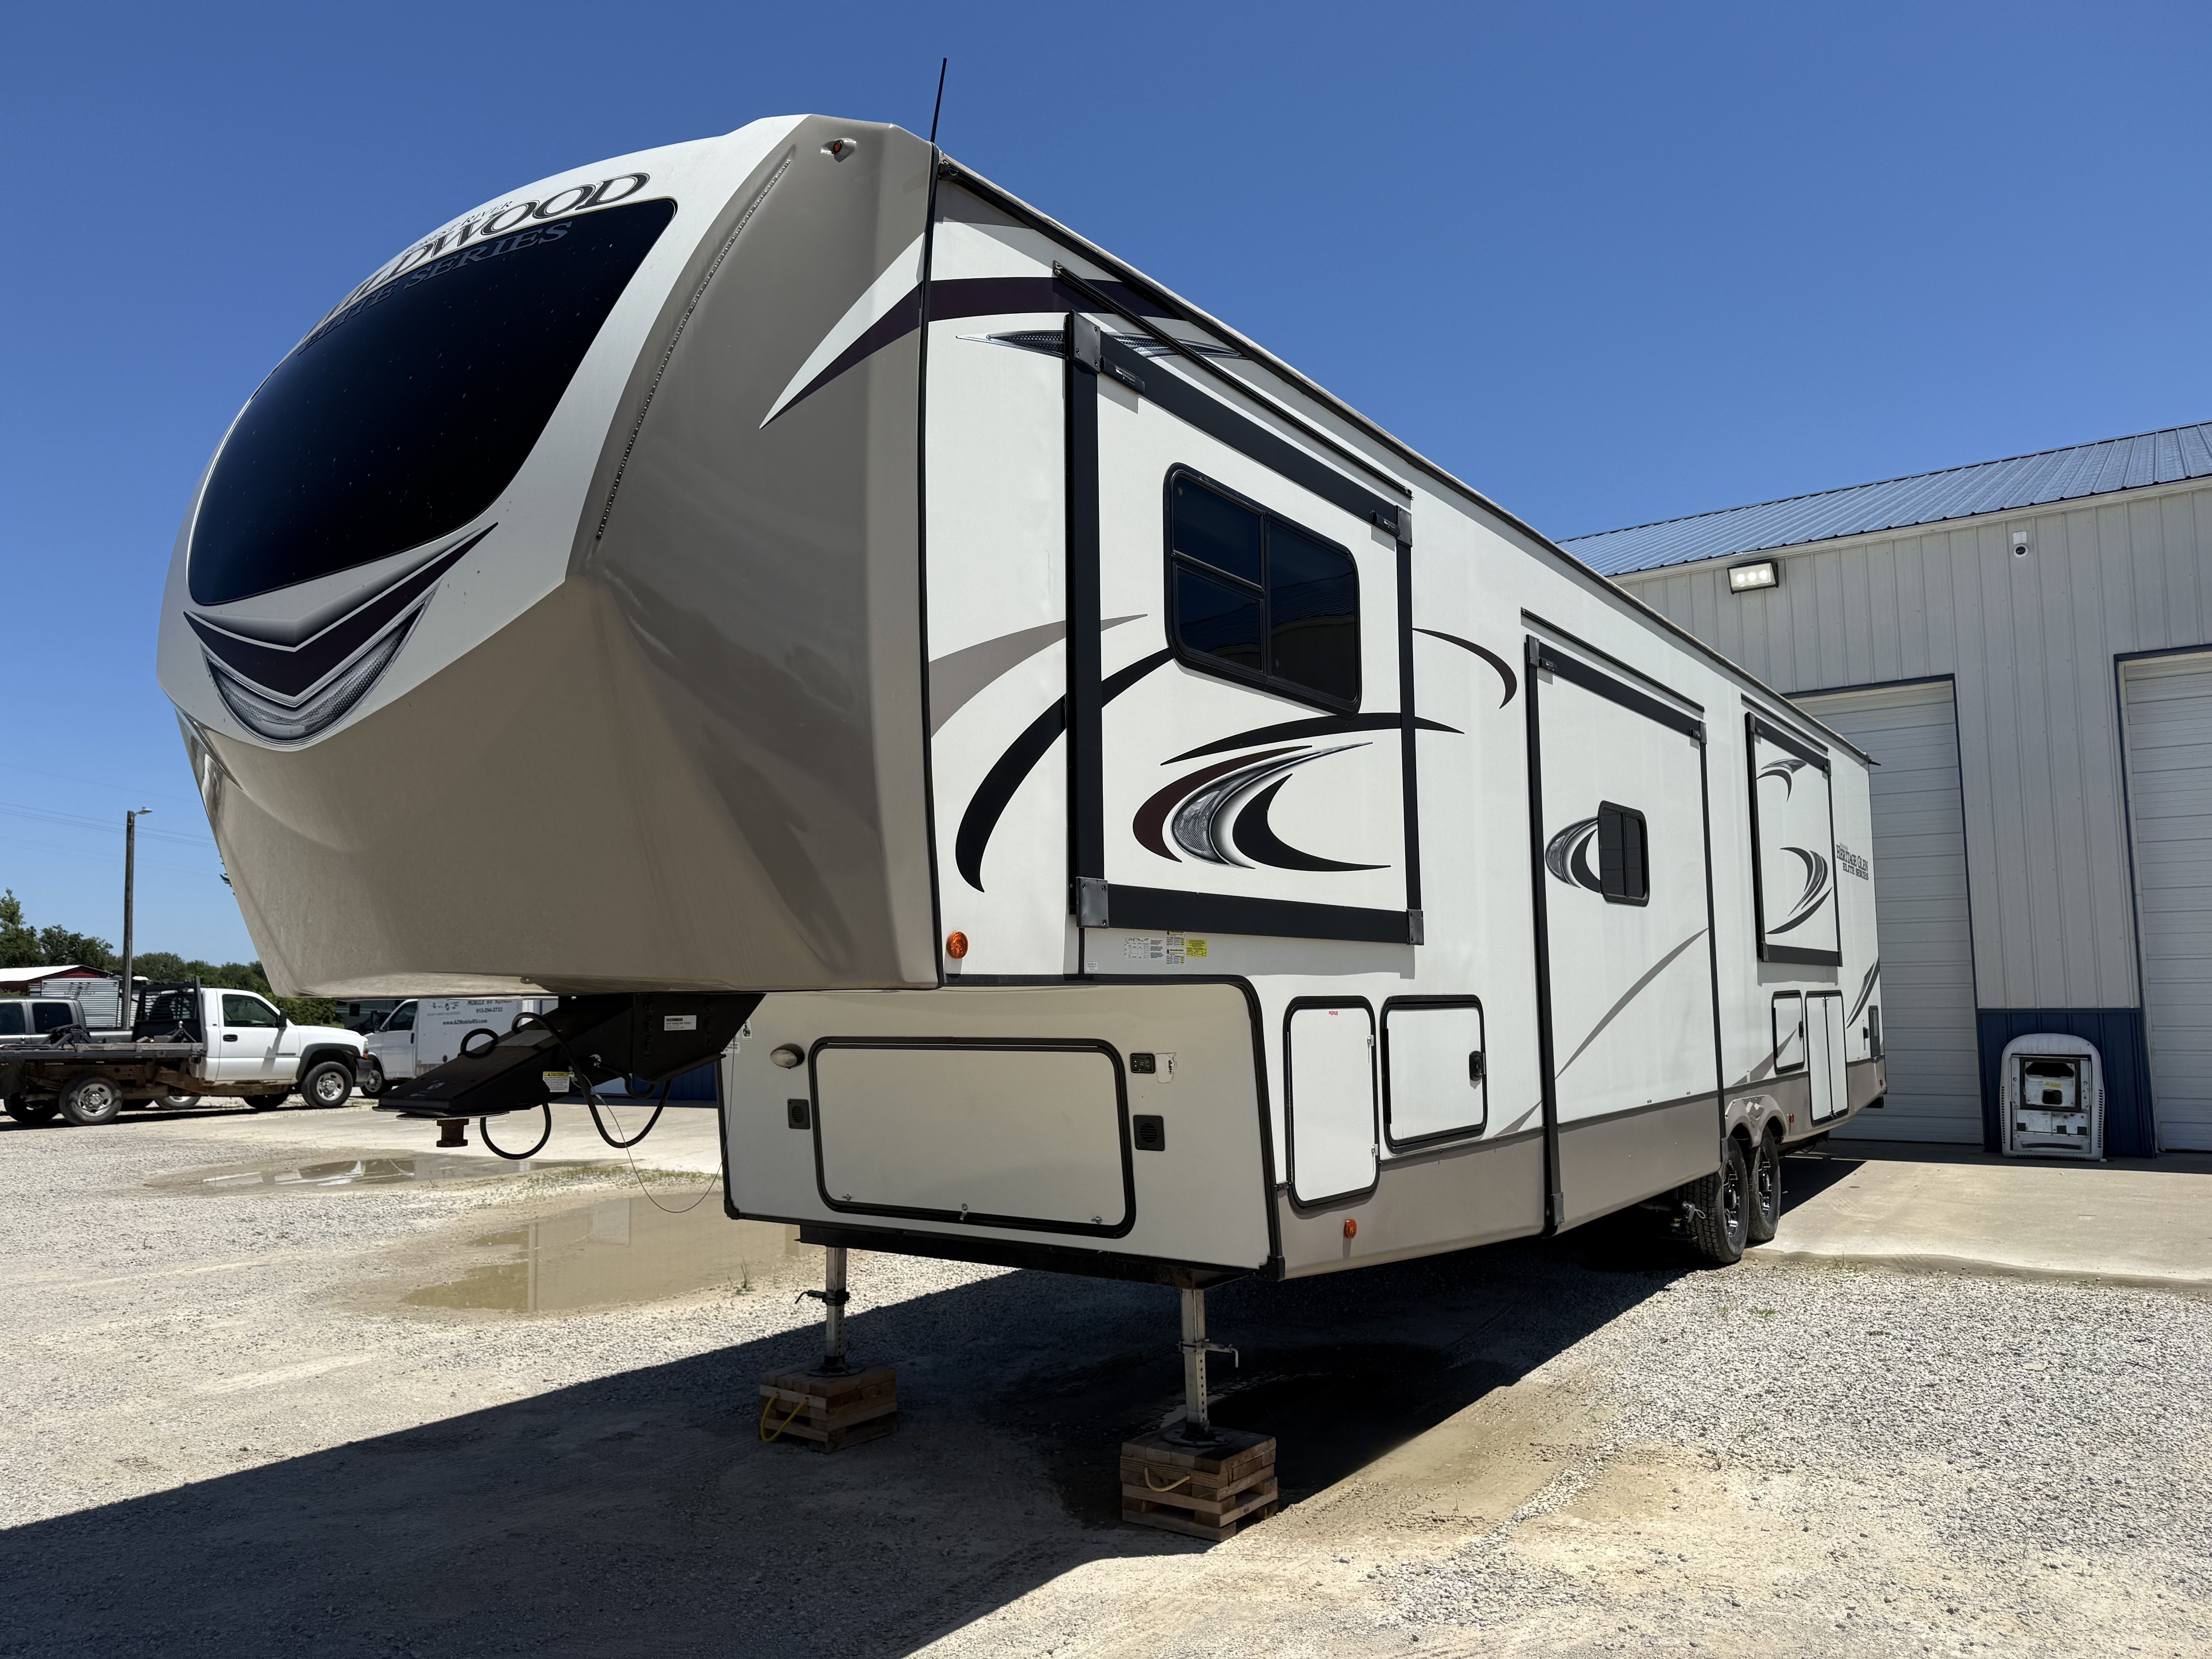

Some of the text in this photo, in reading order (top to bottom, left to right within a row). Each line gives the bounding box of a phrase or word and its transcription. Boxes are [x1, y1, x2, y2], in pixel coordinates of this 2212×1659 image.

[460, 201, 513, 227] RIVER
[302, 172, 651, 342] WILDWOOD
[297, 221, 572, 356] ELITE SERIES
[1836, 844, 1857, 867] HERITAGE
[1857, 855, 1869, 872] GLEN
[1843, 862, 1869, 881] ELITE SERIES
